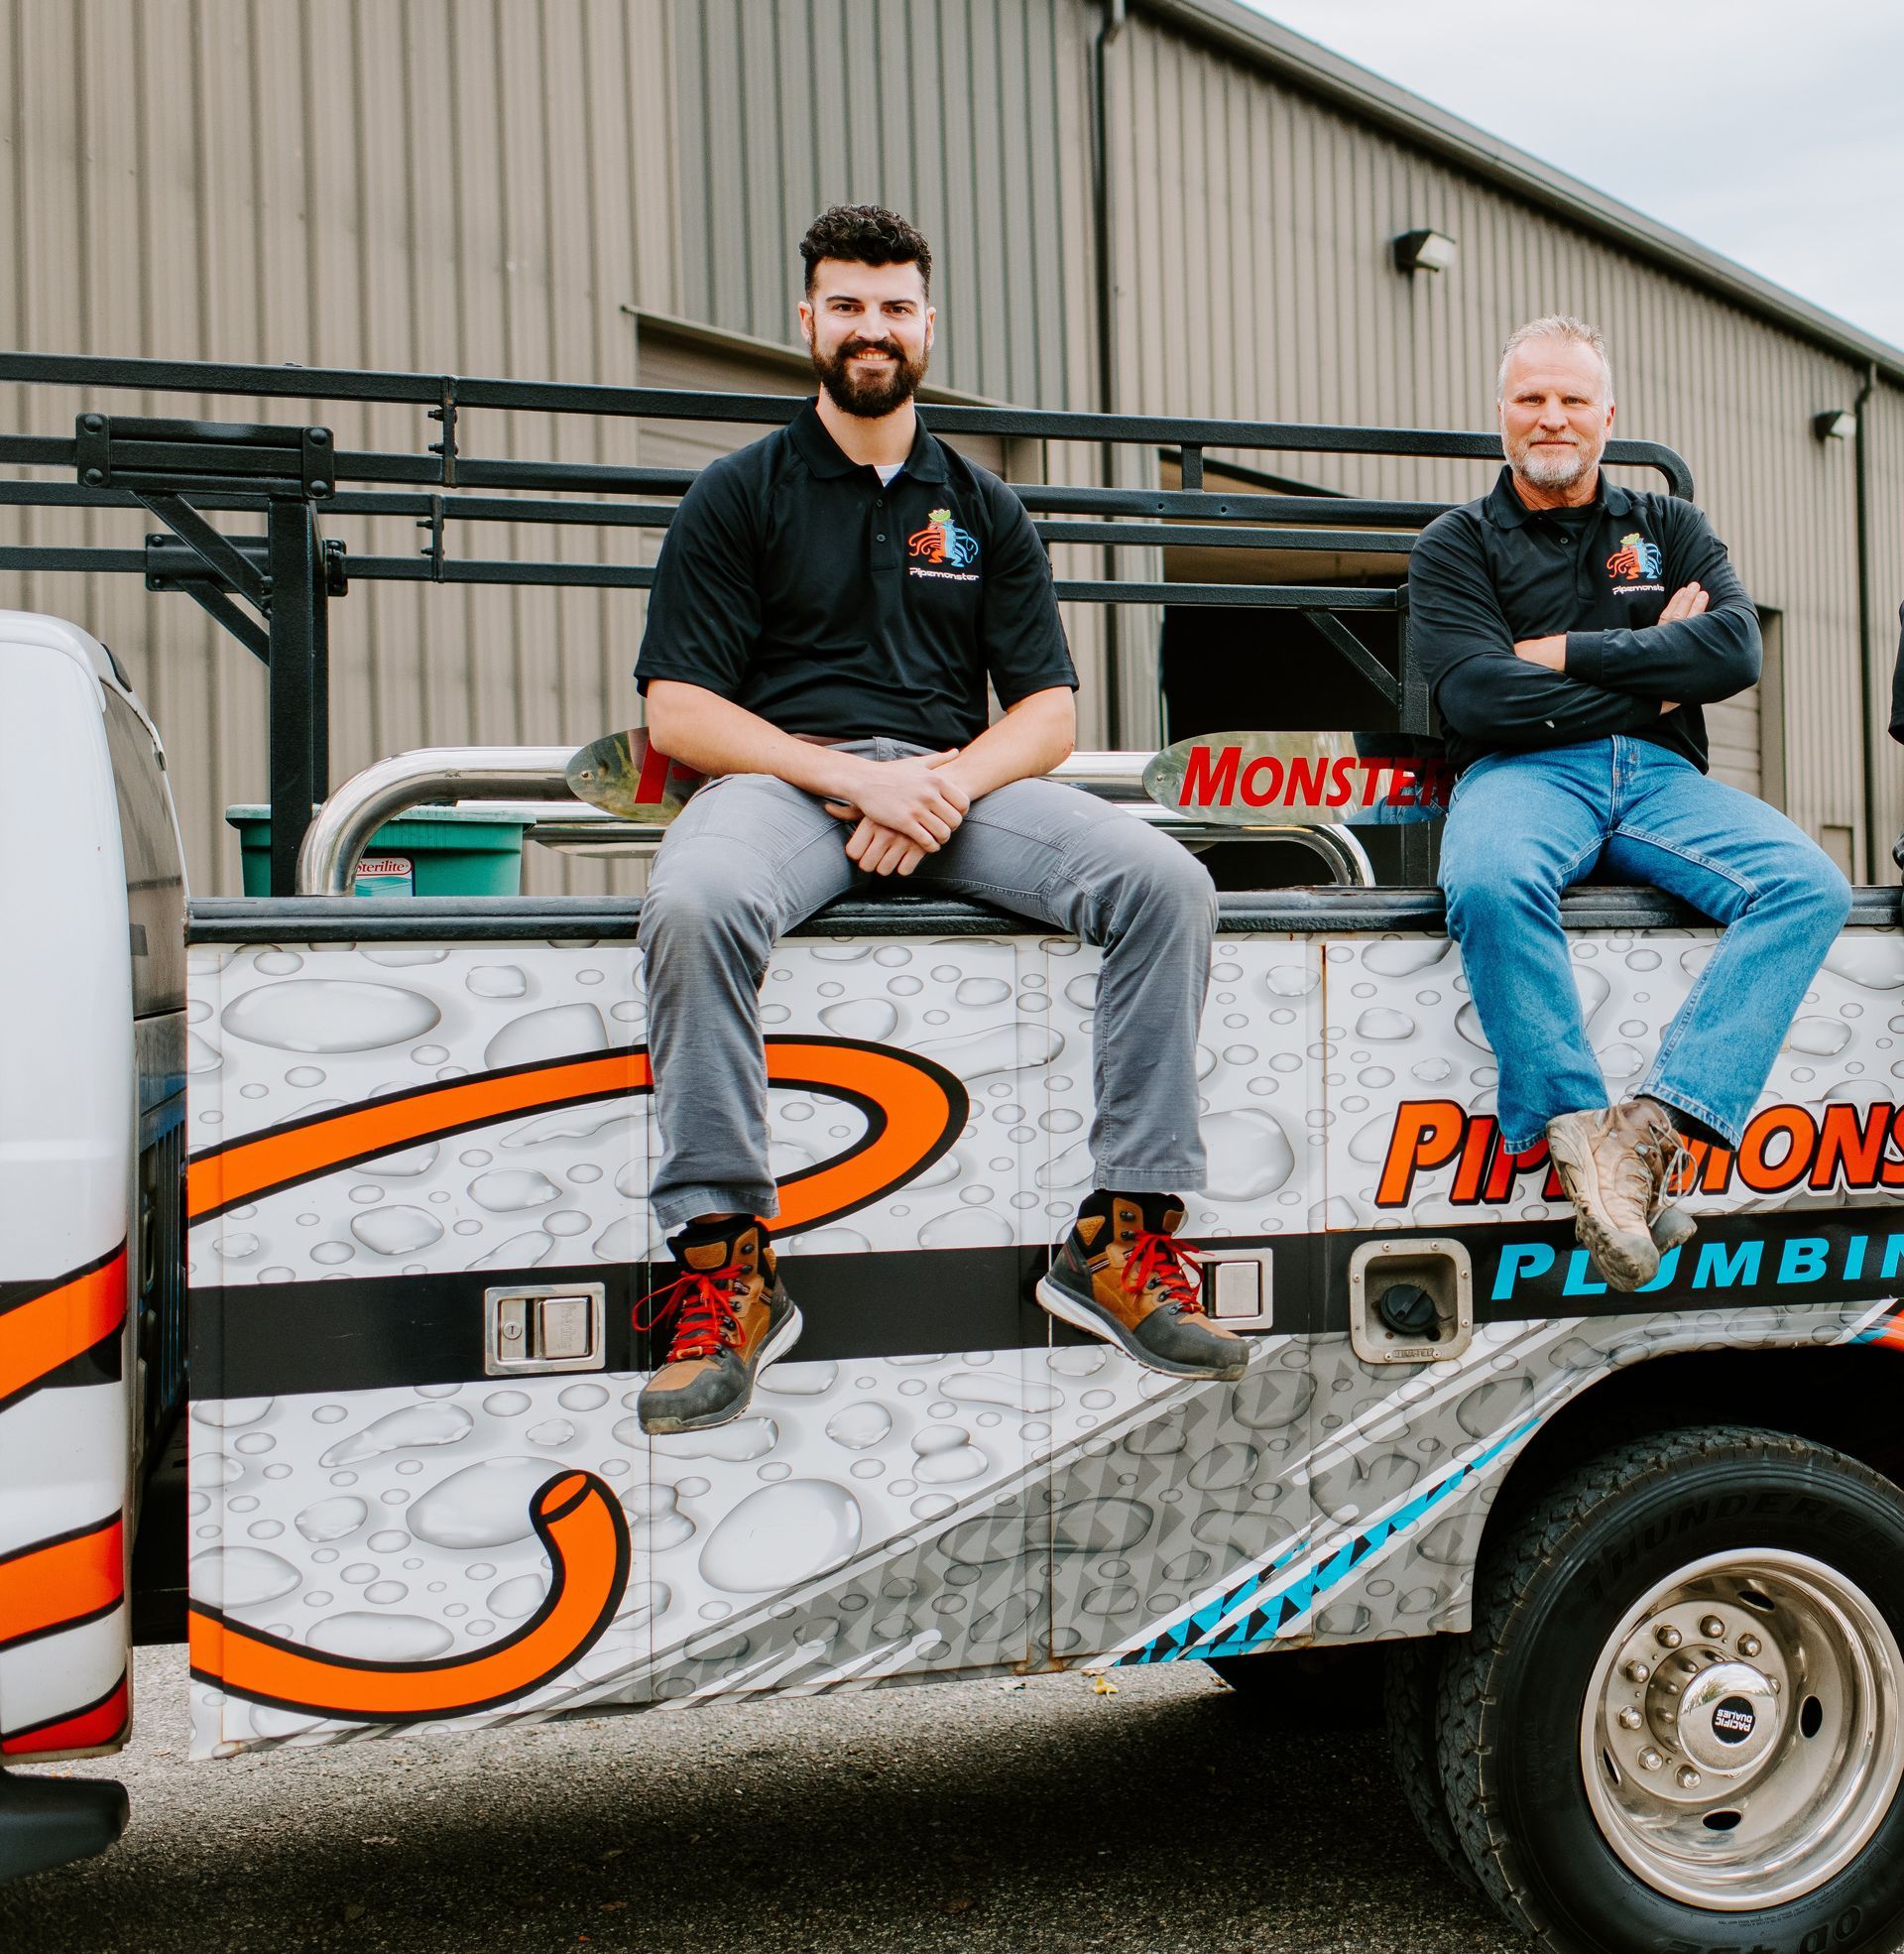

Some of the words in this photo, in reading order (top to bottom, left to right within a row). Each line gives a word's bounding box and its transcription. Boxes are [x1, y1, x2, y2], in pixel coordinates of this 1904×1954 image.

[909, 567, 979, 581] Pipemonster
[1717, 1709, 1753, 1724] DUALIES
[1715, 1717, 1751, 1733] PACIFIC
